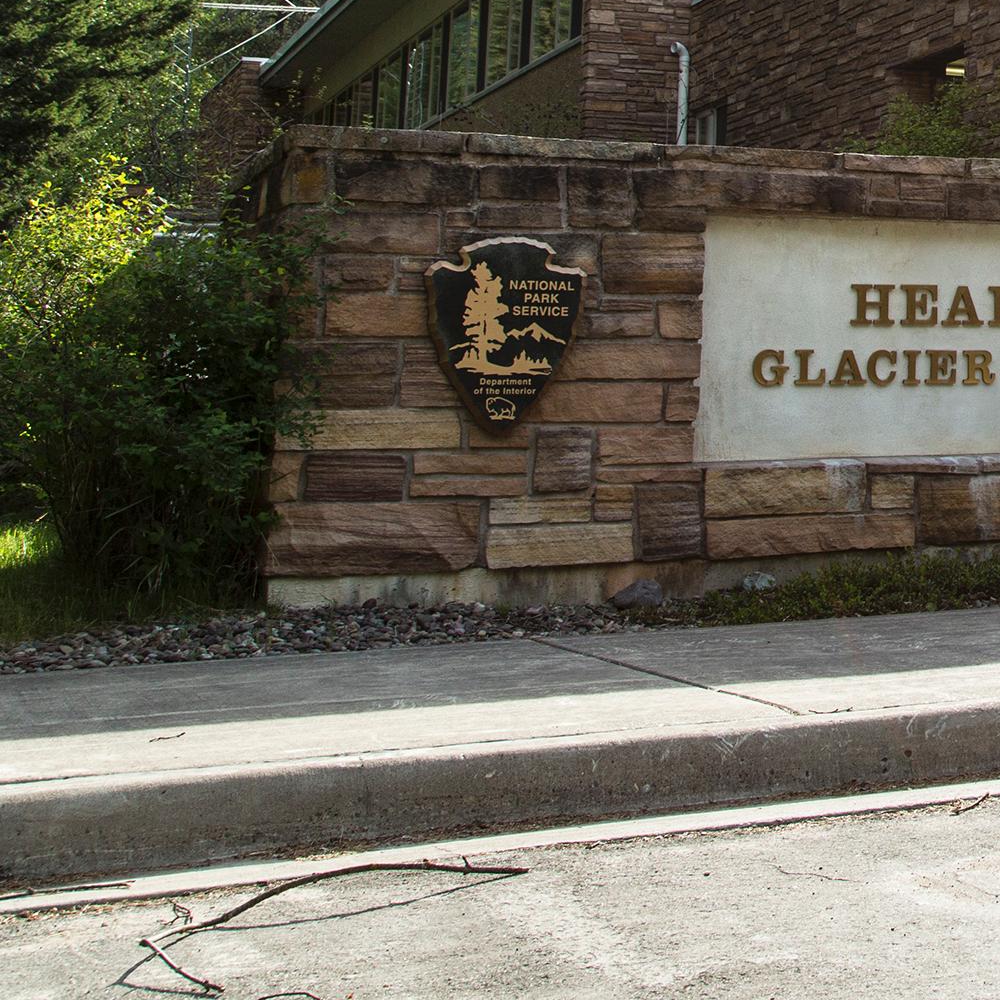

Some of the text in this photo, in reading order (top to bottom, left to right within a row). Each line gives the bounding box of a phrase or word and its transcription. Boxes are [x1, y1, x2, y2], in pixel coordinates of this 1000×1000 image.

[509, 280, 575, 291] NATIONAL
[524, 293, 559, 304] PARK
[512, 306, 569, 317] SERVICE
[752, 348, 997, 387] GLACIER
[480, 378, 532, 386] Department
